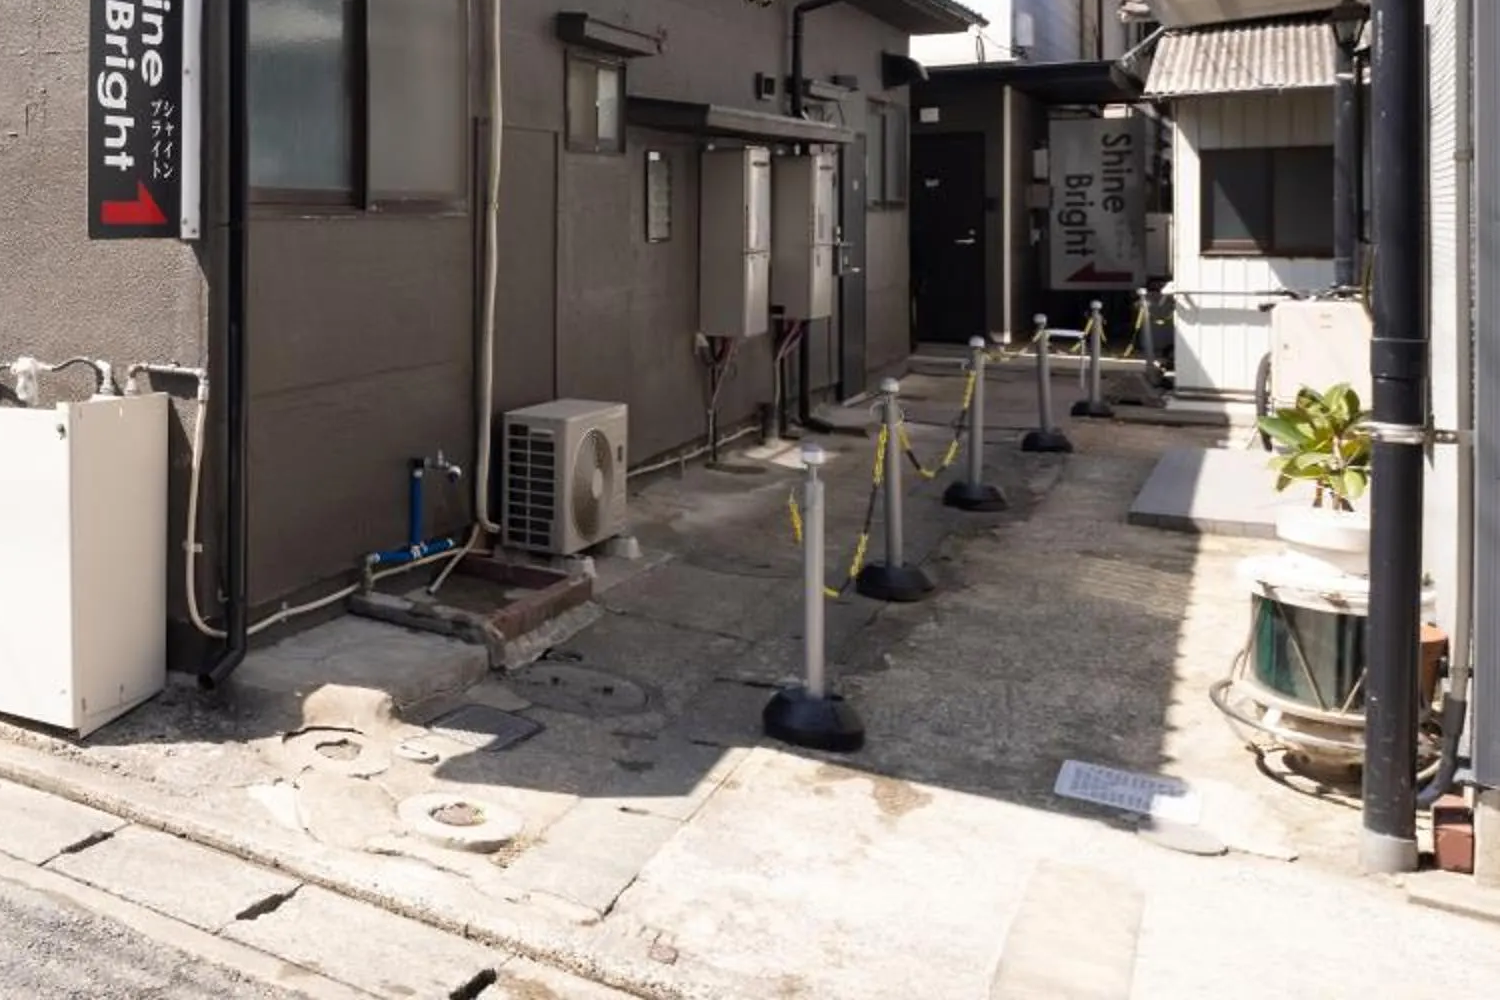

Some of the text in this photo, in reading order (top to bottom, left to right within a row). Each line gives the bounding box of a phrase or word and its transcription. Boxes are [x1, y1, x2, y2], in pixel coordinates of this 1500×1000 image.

[97, 0, 135, 171] Bright
[1058, 173, 1095, 257] Bright
[1102, 133, 1132, 214] Shine
